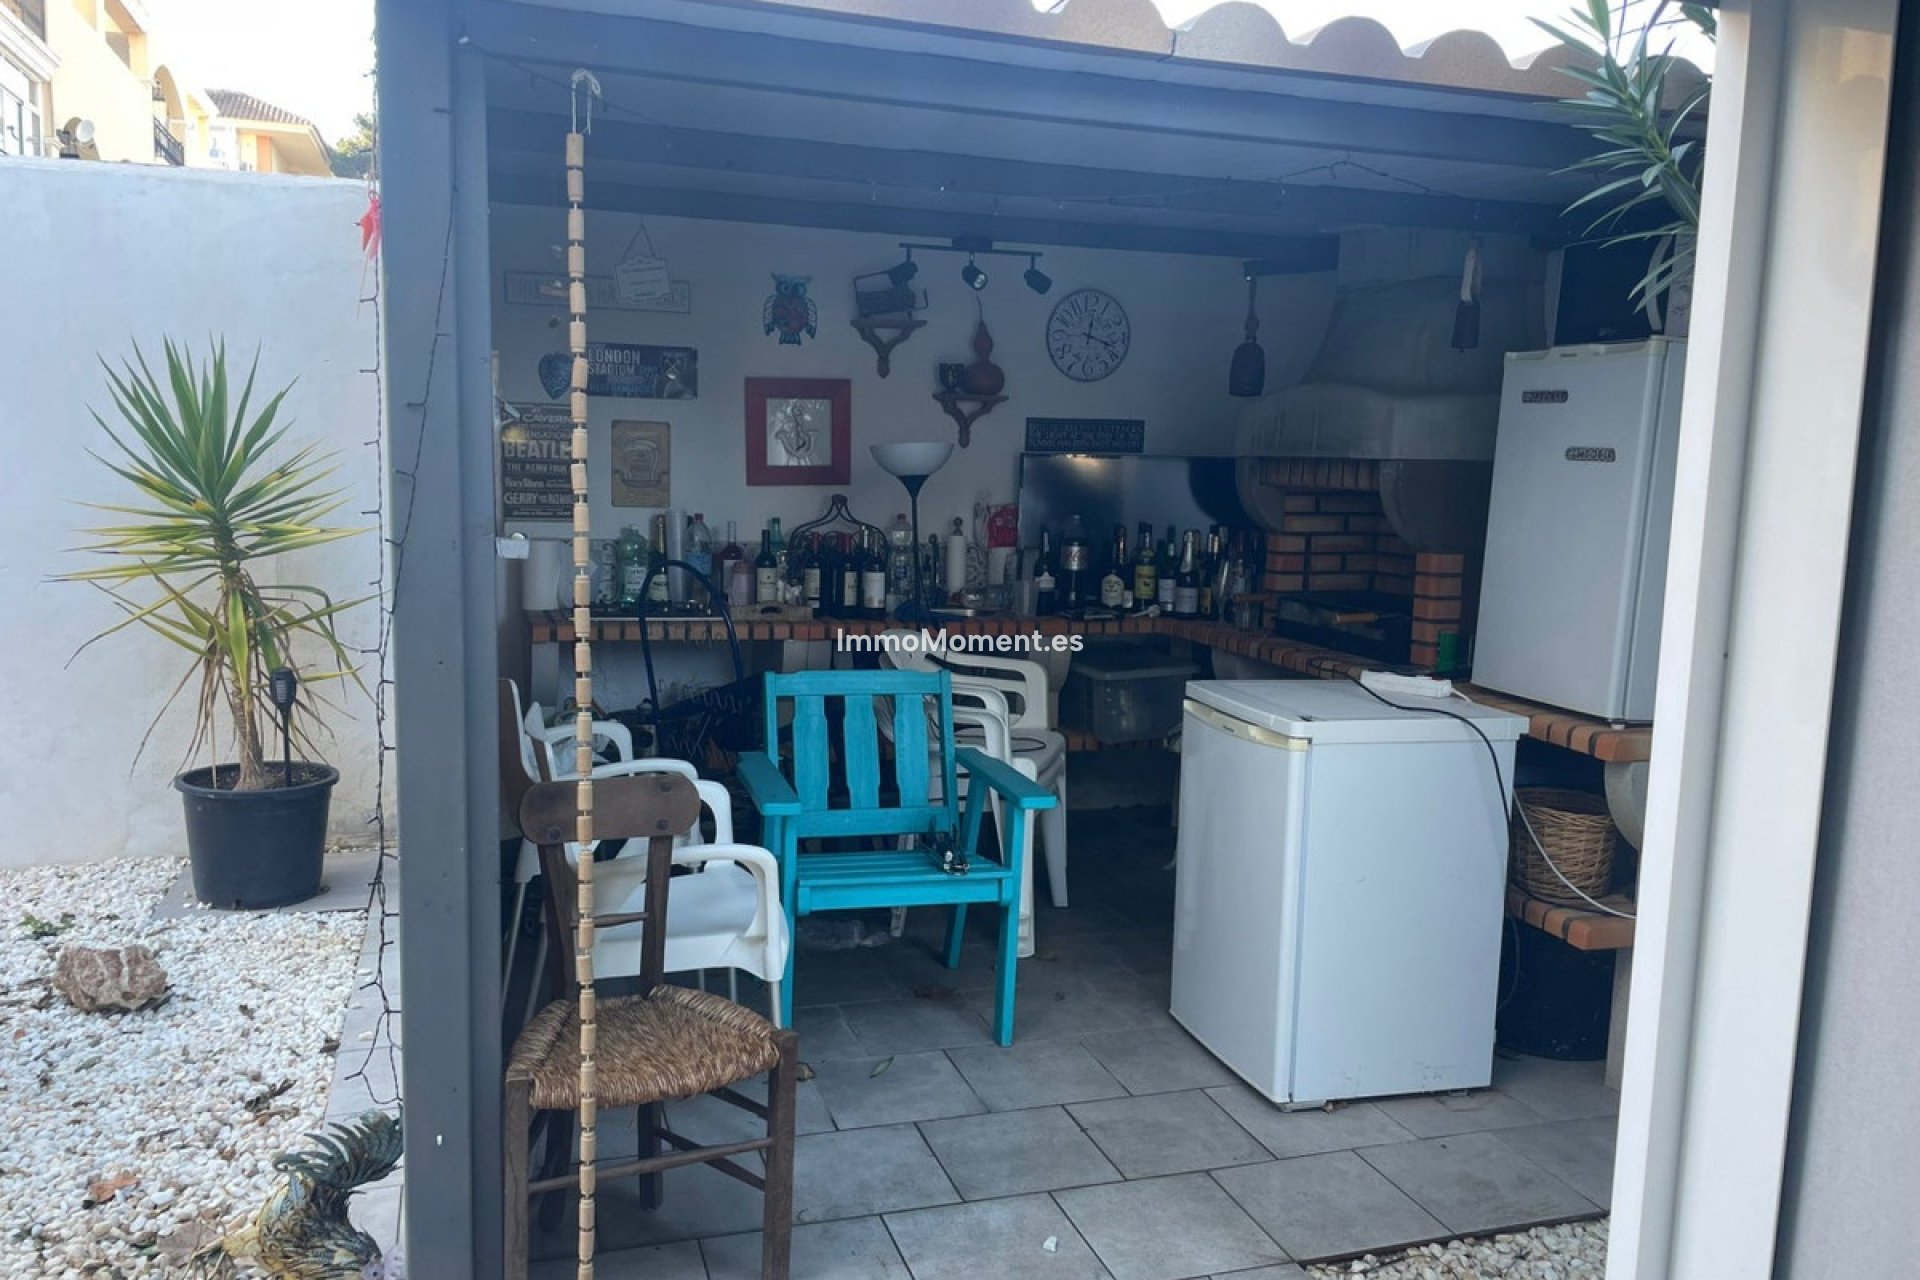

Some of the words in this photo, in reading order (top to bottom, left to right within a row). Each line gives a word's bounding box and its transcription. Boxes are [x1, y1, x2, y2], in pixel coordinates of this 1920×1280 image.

[588, 349, 641, 366] LONDON
[503, 440, 571, 460] BEATLE
[503, 492, 537, 505] GERRY
